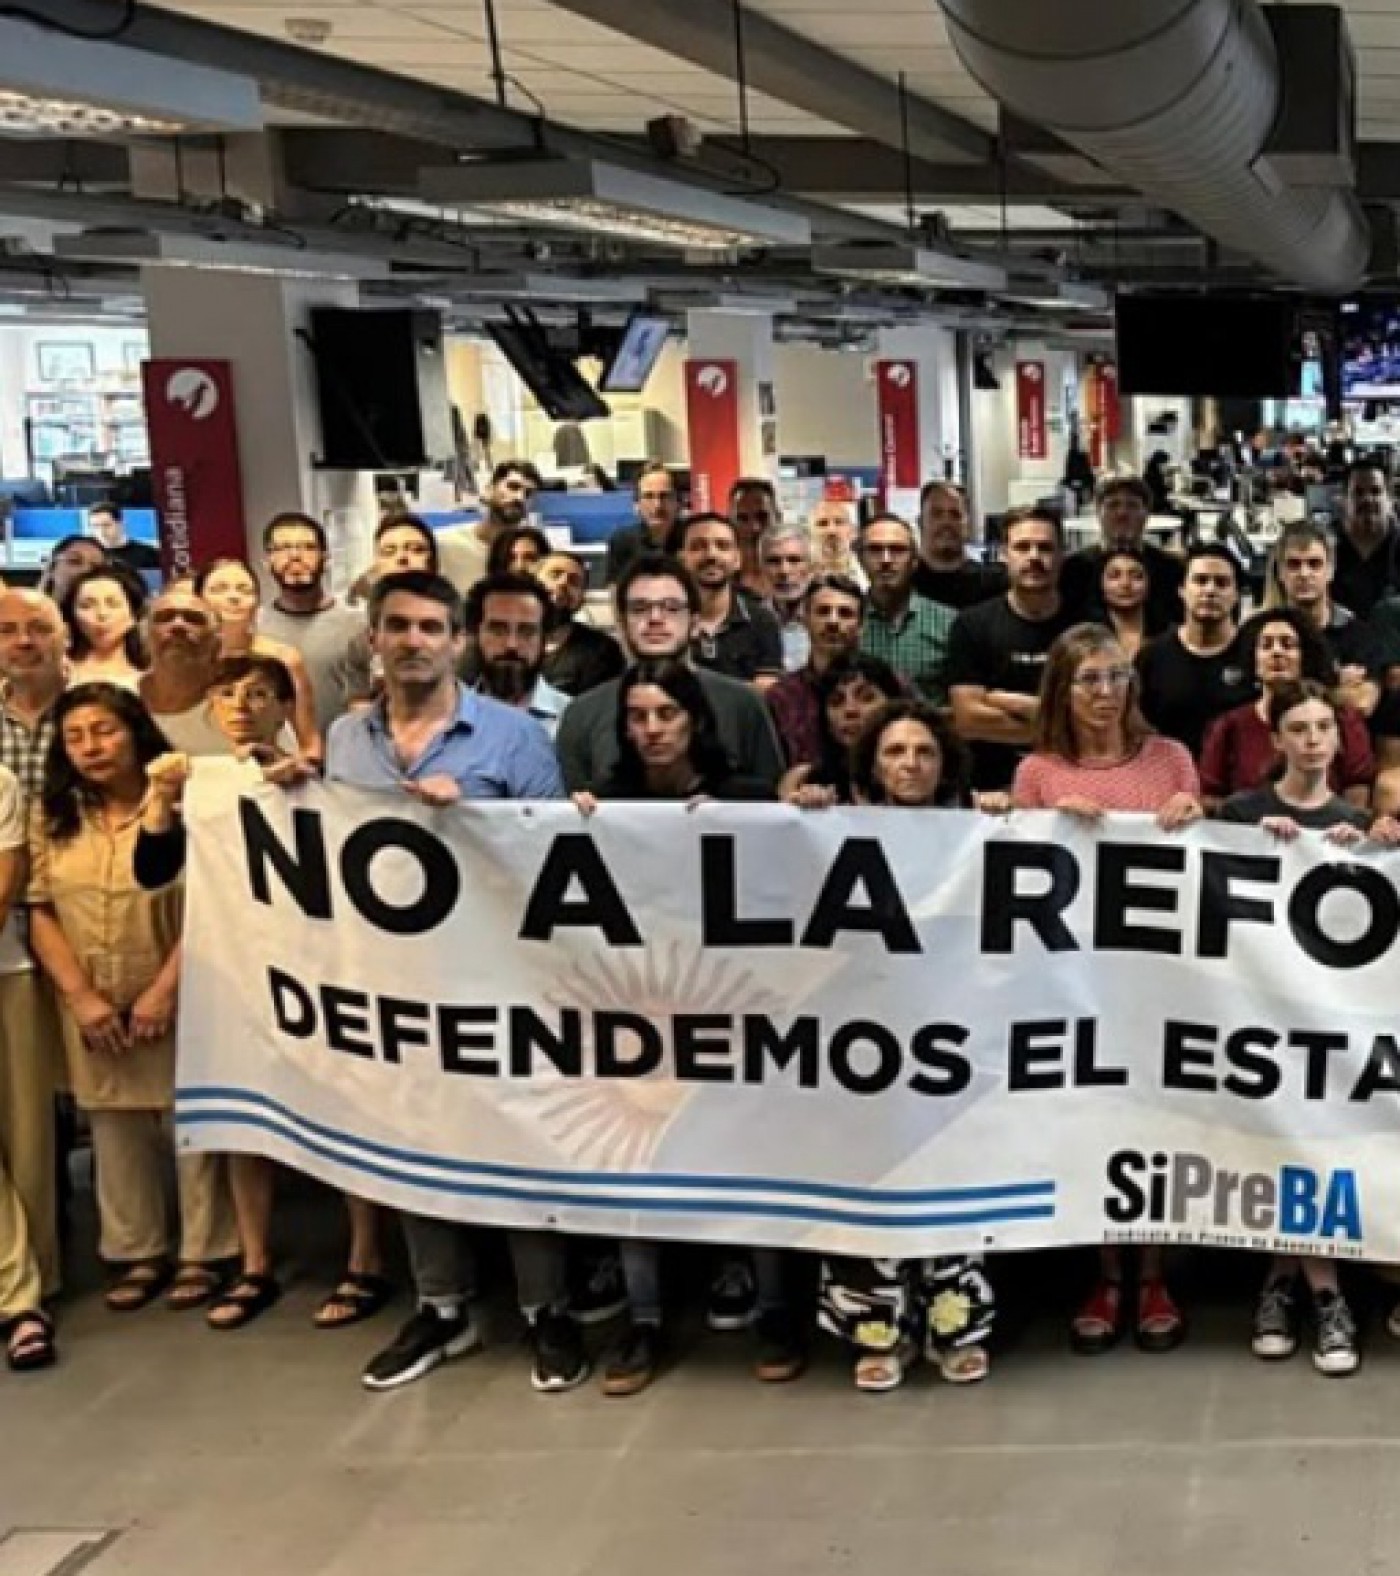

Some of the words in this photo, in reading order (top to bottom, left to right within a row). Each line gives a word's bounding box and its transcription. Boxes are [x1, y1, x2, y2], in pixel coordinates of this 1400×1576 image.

[238, 796, 461, 935] NO
[518, 833, 643, 947] A
[700, 835, 922, 955] LA
[267, 966, 972, 1097] DEFENDEMOS
[1007, 1017, 1128, 1092] EL
[1103, 1149, 1363, 1241] SiPreBA
